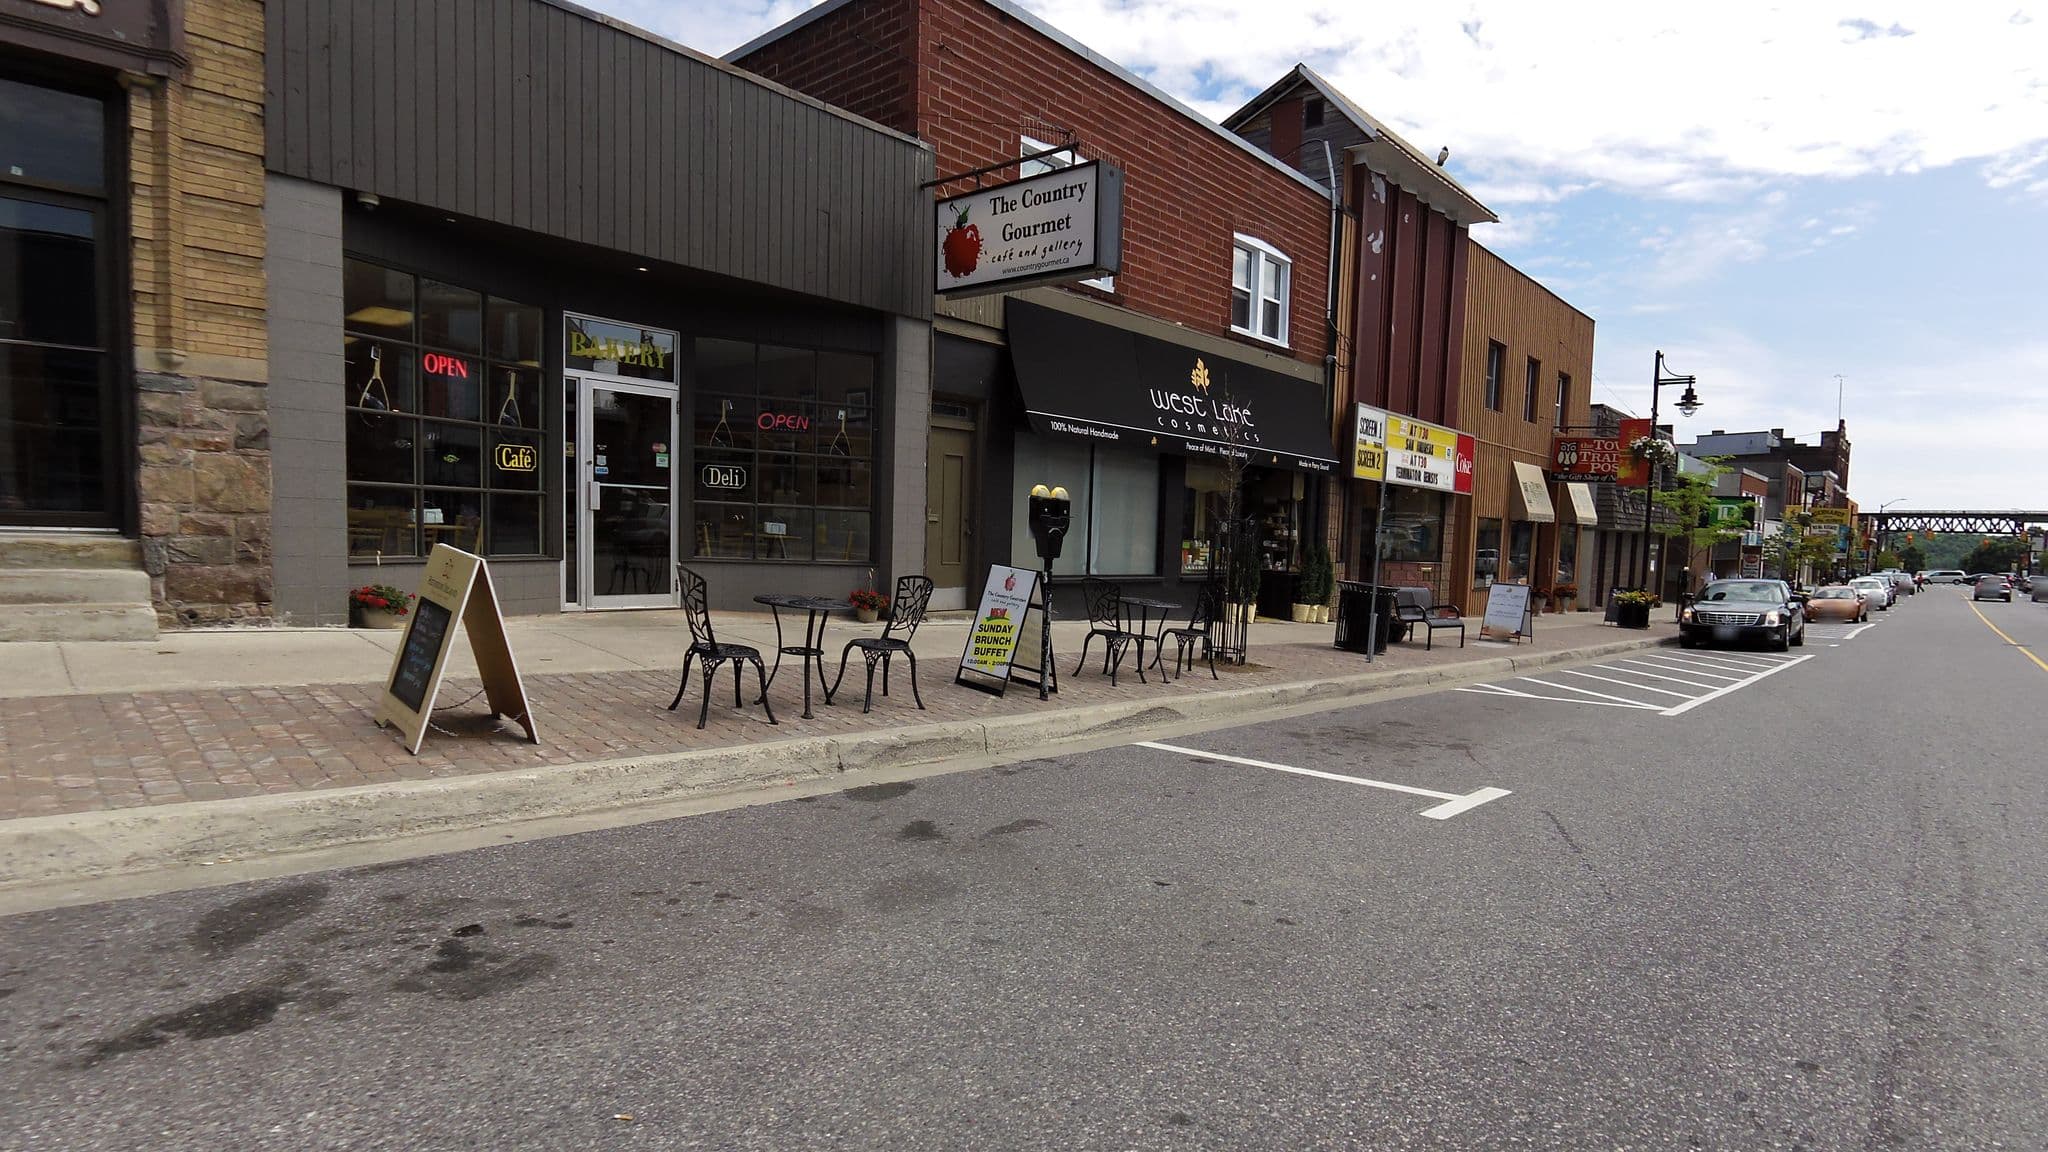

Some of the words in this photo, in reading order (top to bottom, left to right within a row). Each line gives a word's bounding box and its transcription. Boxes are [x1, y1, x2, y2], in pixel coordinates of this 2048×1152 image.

[990, 196, 1018, 216] The
[1021, 182, 1088, 208] Country
[1002, 213, 1072, 242] Gourmet
[991, 249, 1013, 264] café
[1018, 246, 1037, 258] and
[1041, 239, 1083, 260] gallery
[1001, 256, 1070, 276] www.countrygourmet.ca
[570, 331, 666, 370] BAKERY
[424, 353, 469, 378] OPEN
[757, 412, 809, 430] OPEN
[1050, 420, 1067, 432] 100%
[1067, 424, 1089, 436] Natural
[1089, 428, 1119, 440] Handmade
[1359, 417, 1377, 437] SCREEN
[1379, 422, 1382, 439] 1
[1409, 424, 1417, 438] AT
[1185, 441, 1199, 451] Peace
[502, 447, 532, 469] Café
[1357, 449, 1376, 469] SCREEN
[1376, 453, 1381, 470] 2
[1409, 453, 1417, 467] AT
[1456, 452, 1473, 474] Coke
[709, 467, 740, 487] Deli
[978, 623, 1014, 634] SUNDAY
[974, 635, 1012, 646] BRUNCH
[973, 647, 1009, 657] BUFFET
